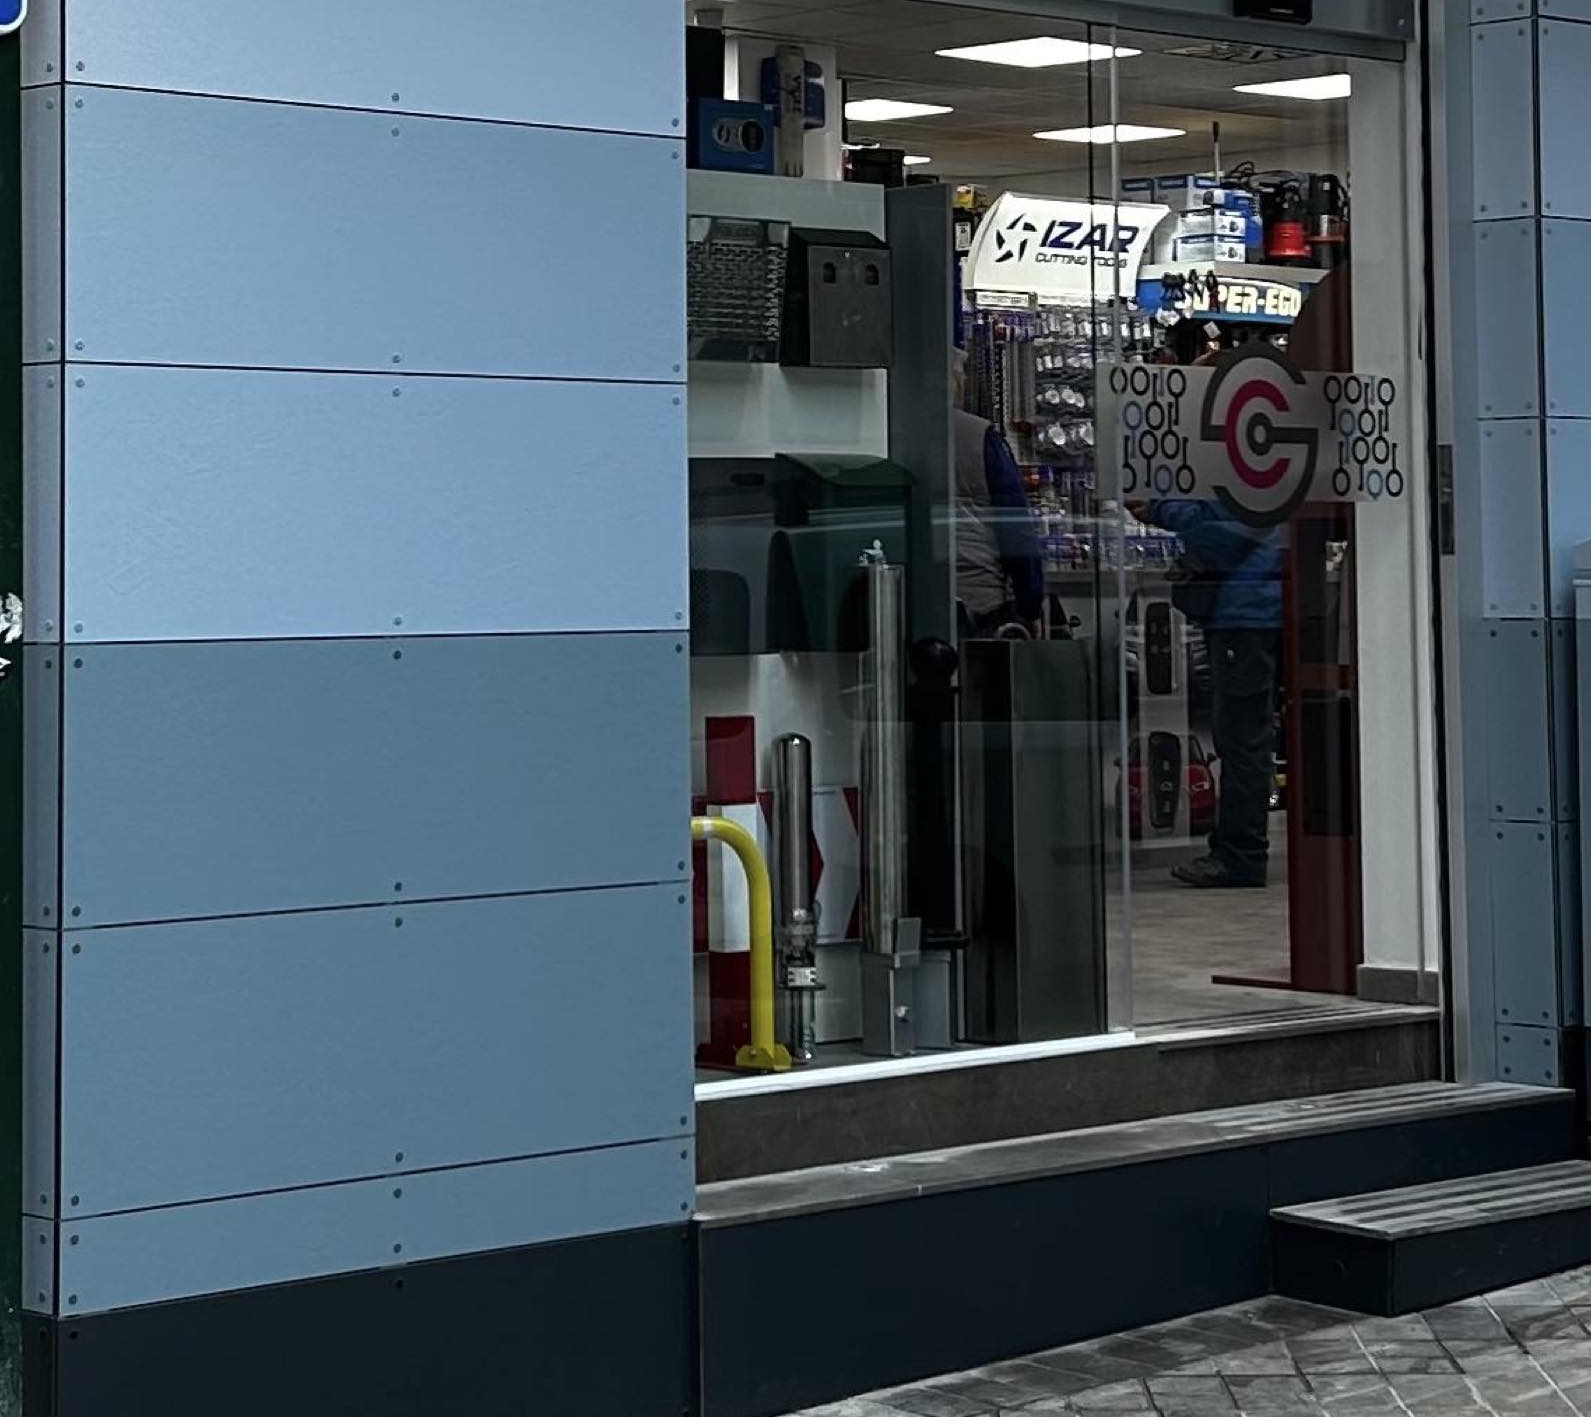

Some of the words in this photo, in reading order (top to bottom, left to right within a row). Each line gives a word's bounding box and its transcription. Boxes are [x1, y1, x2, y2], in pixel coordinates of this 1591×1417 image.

[1039, 220, 1140, 253] IZAR
[1035, 252, 1088, 266] CUTTING
[1094, 256, 1128, 269] TOOS
